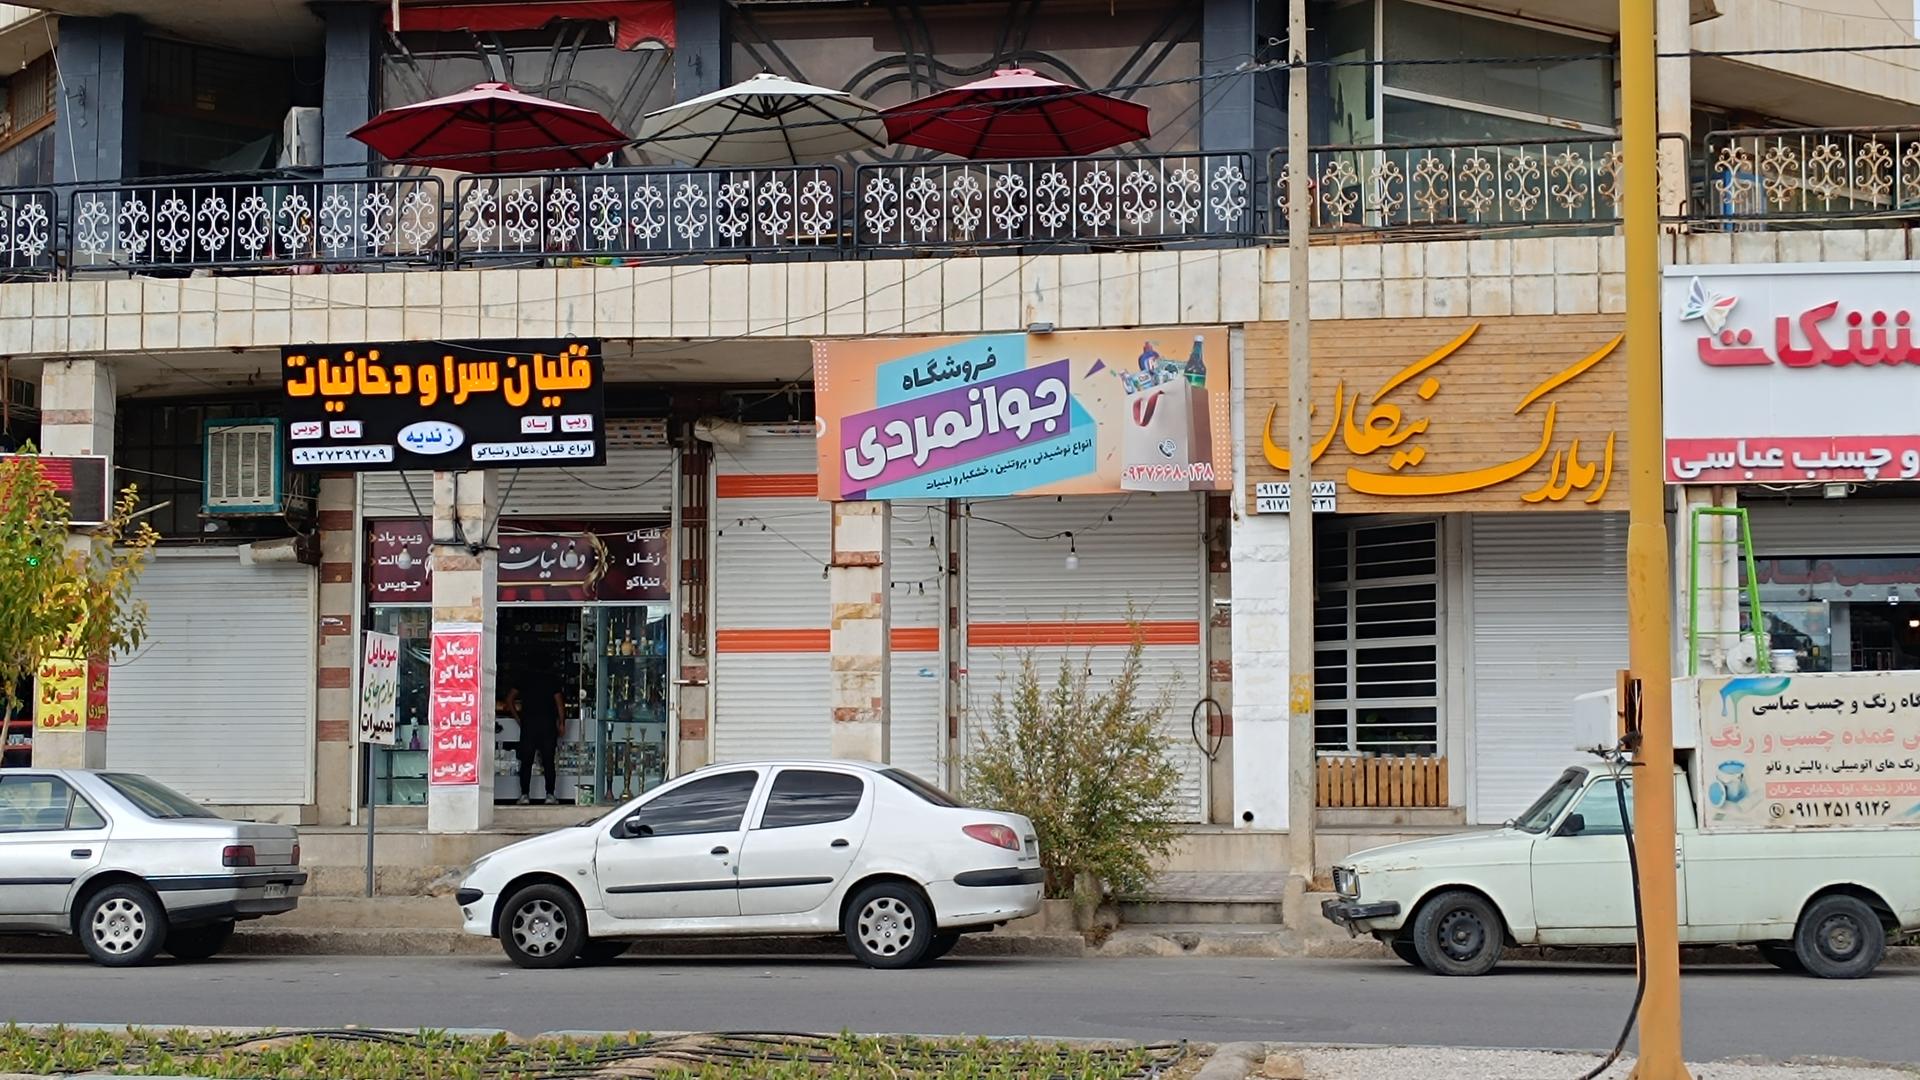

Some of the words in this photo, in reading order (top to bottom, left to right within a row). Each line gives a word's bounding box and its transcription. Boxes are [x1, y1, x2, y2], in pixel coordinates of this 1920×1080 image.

[1697, 300, 1920, 368] شکات
[503, 344, 592, 408] قلیان
[902, 346, 997, 391] فروشگاه
[287, 350, 412, 412] دخانیات
[417, 364, 438, 407] و
[444, 355, 499, 405] سرا
[1347, 332, 1625, 504] املاک
[292, 424, 319, 436] جویس
[334, 424, 356, 435] سالت
[406, 427, 454, 449] زندیه
[844, 377, 1068, 482] جوانمردی
[540, 443, 565, 456] قلیان
[567, 443, 591, 456] انواع
[1033, 444, 1071, 465] نوشیدنی
[1072, 438, 1092, 456] انواع
[1672, 440, 1785, 480] عباسی
[1791, 447, 1893, 481] چسب
[1899, 448, 1920, 479] و
[926, 475, 952, 490] لبنیات
[959, 465, 989, 485] خشکبار
[378, 531, 396, 548] پاد
[626, 528, 661, 543] قلیان
[498, 540, 586, 579] دانیات
[626, 552, 661, 566] زغال
[378, 580, 421, 592] جویس
[626, 576, 660, 590] تنباکو
[367, 639, 397, 668] موبایل
[438, 664, 474, 684] تنباکو
[1752, 695, 1800, 716] عباسی
[1804, 696, 1845, 716] چسب
[1850, 702, 1859, 714] و
[1862, 692, 1896, 714] رنگ
[361, 713, 394, 740] تعمیرات
[439, 711, 472, 731] قلیان
[438, 734, 472, 750] سالت
[1709, 725, 1756, 754] رنگ
[1761, 733, 1773, 753] و
[1779, 728, 1836, 752] چسب
[1841, 727, 1896, 745] عمده
[433, 760, 475, 778] جویس
[1875, 759, 1896, 773] های
[1789, 801, 1819, 817] ۰۹۱۱
[1824, 801, 1851, 817] ۲۵۱
